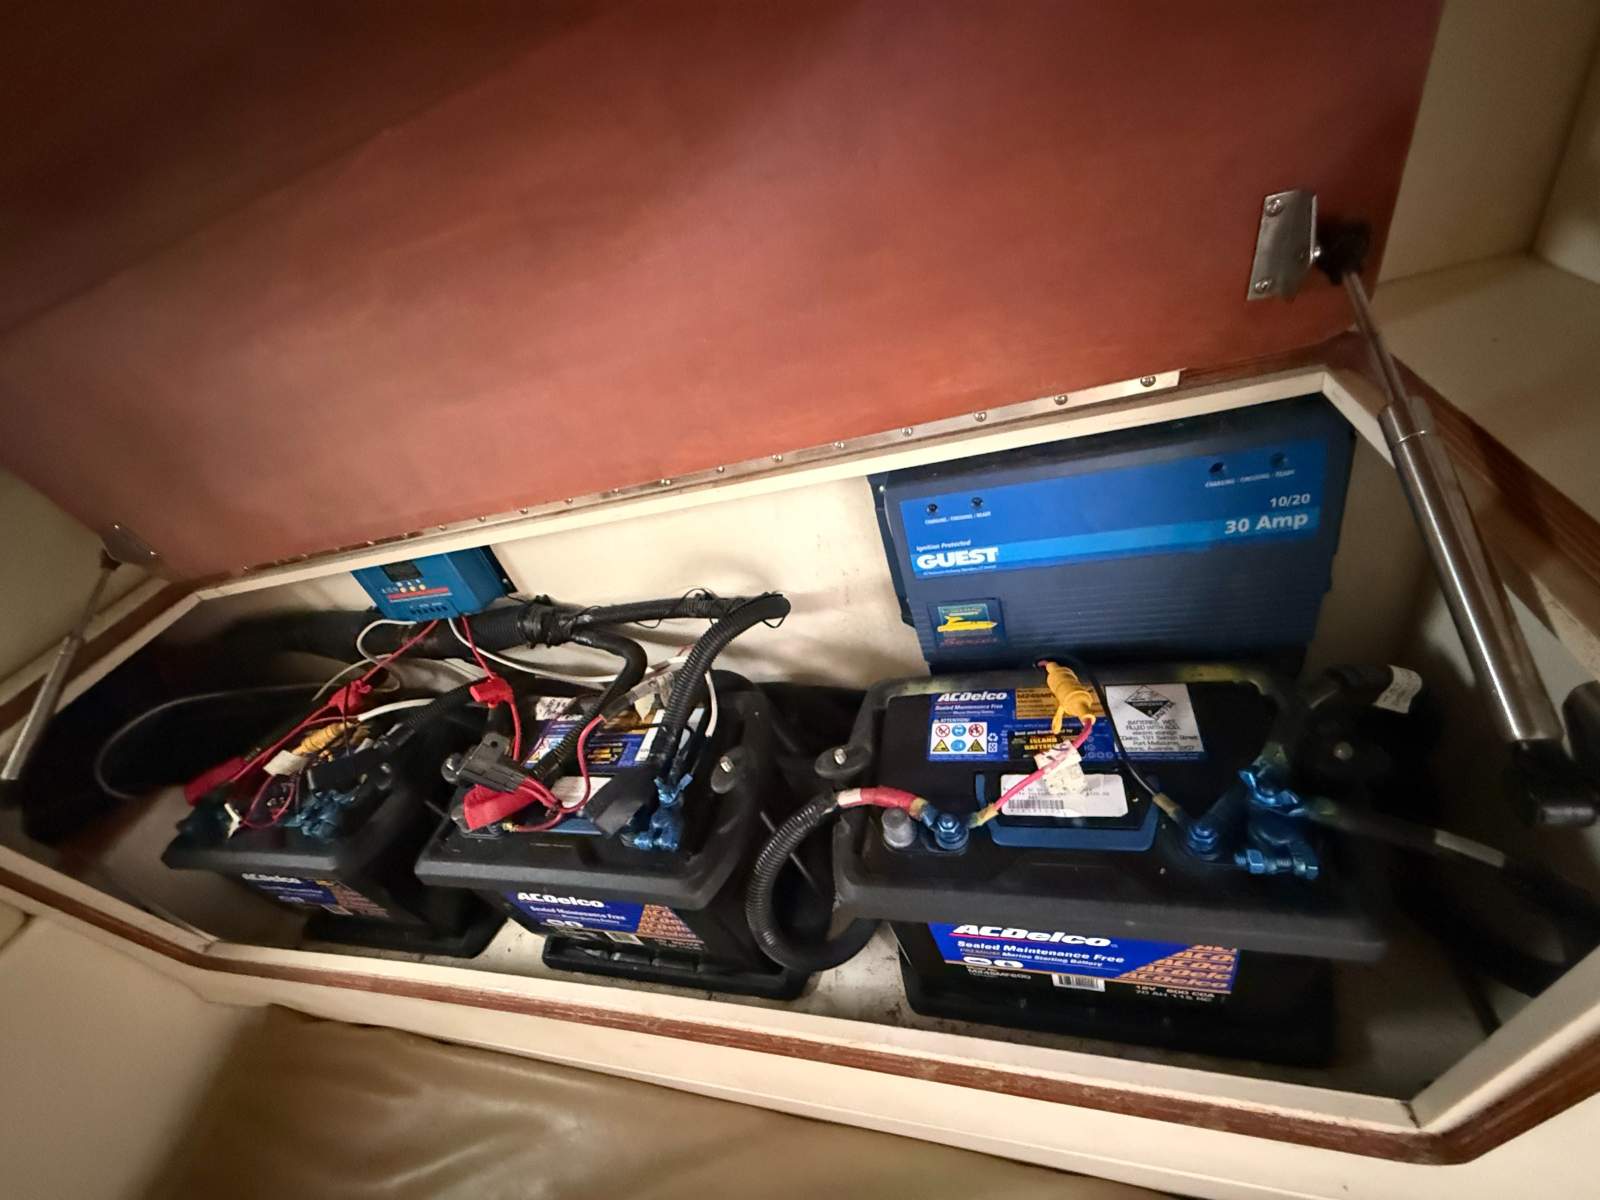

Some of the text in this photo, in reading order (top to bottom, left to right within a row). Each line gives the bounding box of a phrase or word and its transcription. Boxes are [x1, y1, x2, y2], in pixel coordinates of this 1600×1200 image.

[1269, 493, 1311, 508] 10/20
[1224, 513, 1309, 534] 30 Amp
[916, 547, 999, 570] GUEST
[937, 691, 1009, 702] ACDelco
[517, 891, 606, 909] ACDelco
[952, 924, 1112, 948] ACDelco
[957, 940, 1001, 951] Sealed
[1002, 944, 1090, 959] Maintenance
[1092, 953, 1125, 964] Free
[1001, 952, 1104, 967] Marine Starting Battery
